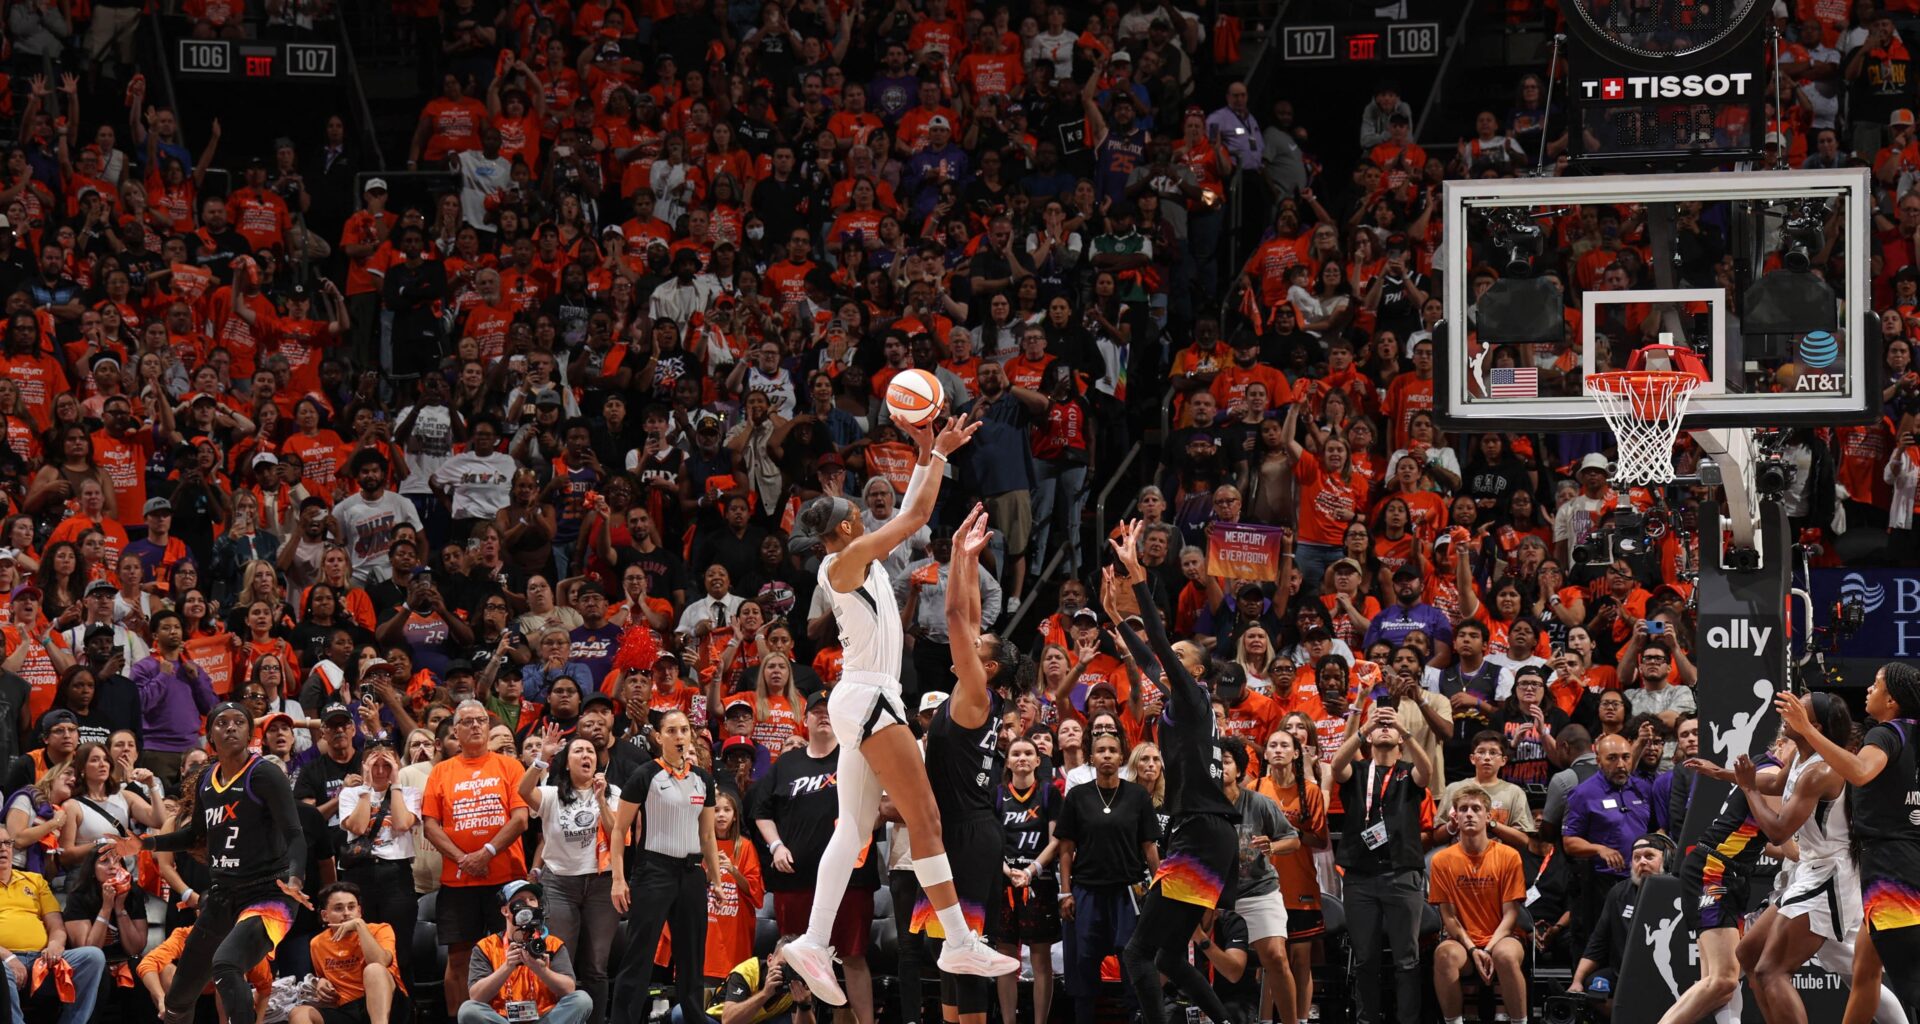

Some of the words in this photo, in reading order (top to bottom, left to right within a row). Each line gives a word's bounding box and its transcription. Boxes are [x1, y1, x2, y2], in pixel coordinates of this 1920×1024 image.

[1293, 31, 1326, 56] 107
[1349, 39, 1376, 60] EXIT
[1397, 28, 1431, 53] 108
[189, 45, 223, 68] 106
[245, 56, 273, 77] EXIT
[296, 49, 328, 73] 107
[1627, 72, 1752, 99] TISSOT
[1868, 65, 1906, 87] CLRK
[1795, 373, 1844, 392] AT&T
[1225, 531, 1266, 547] MERCURY
[1219, 549, 1269, 565] EVERYBODY
[425, 631, 445, 644] 25
[570, 641, 612, 651] PLAY
[1706, 618, 1772, 658] ally
[569, 649, 608, 659] OFFS
[455, 777, 500, 792] MERCURY
[793, 771, 838, 797] PHX
[205, 800, 240, 830] PHX
[455, 816, 504, 831] EVERYBODY
[1003, 804, 1041, 827] PHX
[224, 826, 240, 849] 2
[1018, 831, 1041, 850] 14
[1825, 973, 1842, 990] TV
